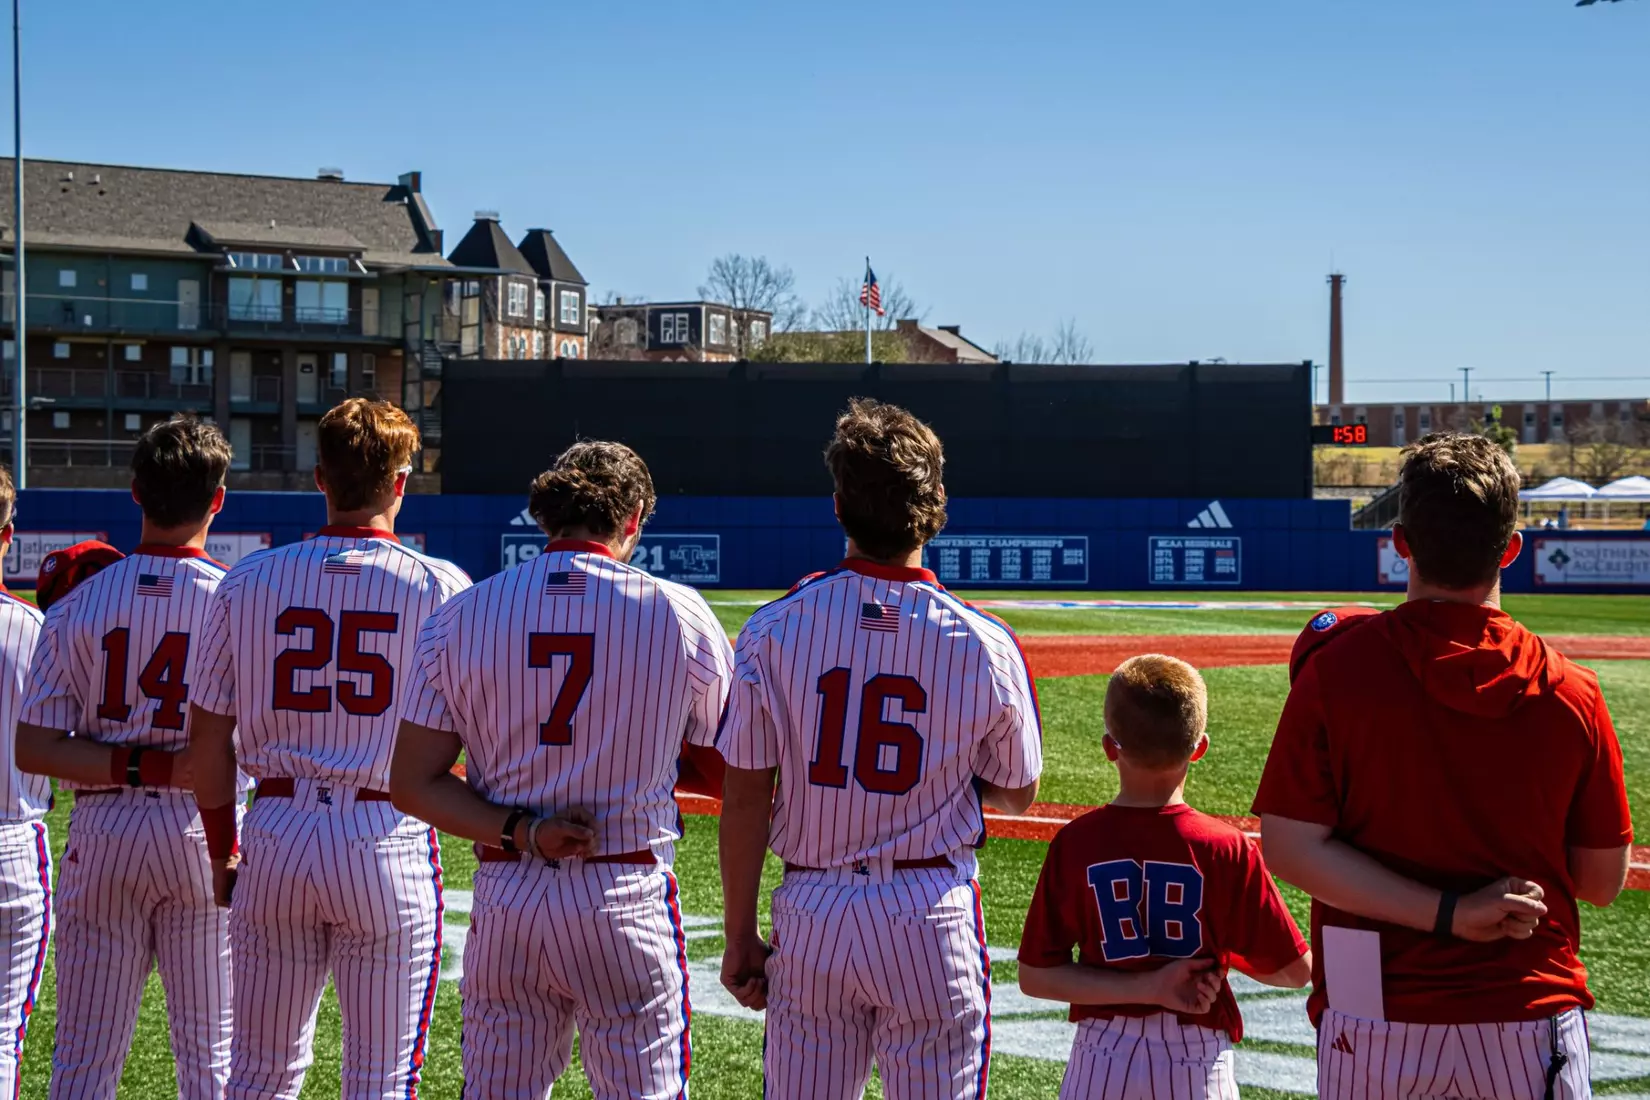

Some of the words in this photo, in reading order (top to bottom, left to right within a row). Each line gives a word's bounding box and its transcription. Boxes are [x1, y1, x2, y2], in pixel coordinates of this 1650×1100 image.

[1334, 425, 1366, 443] 1:58
[929, 539, 986, 548] CONFERENCE
[988, 539, 1063, 549] CHAMPIONSHIPS
[1158, 540, 1183, 548] NCAA
[1185, 540, 1232, 548] REGIONALS
[1573, 547, 1650, 559] SOUTHERN
[97, 627, 191, 731] 14
[272, 606, 399, 716] 25
[528, 632, 595, 746] 7
[808, 666, 928, 795] 16
[1087, 858, 1204, 962] BB
